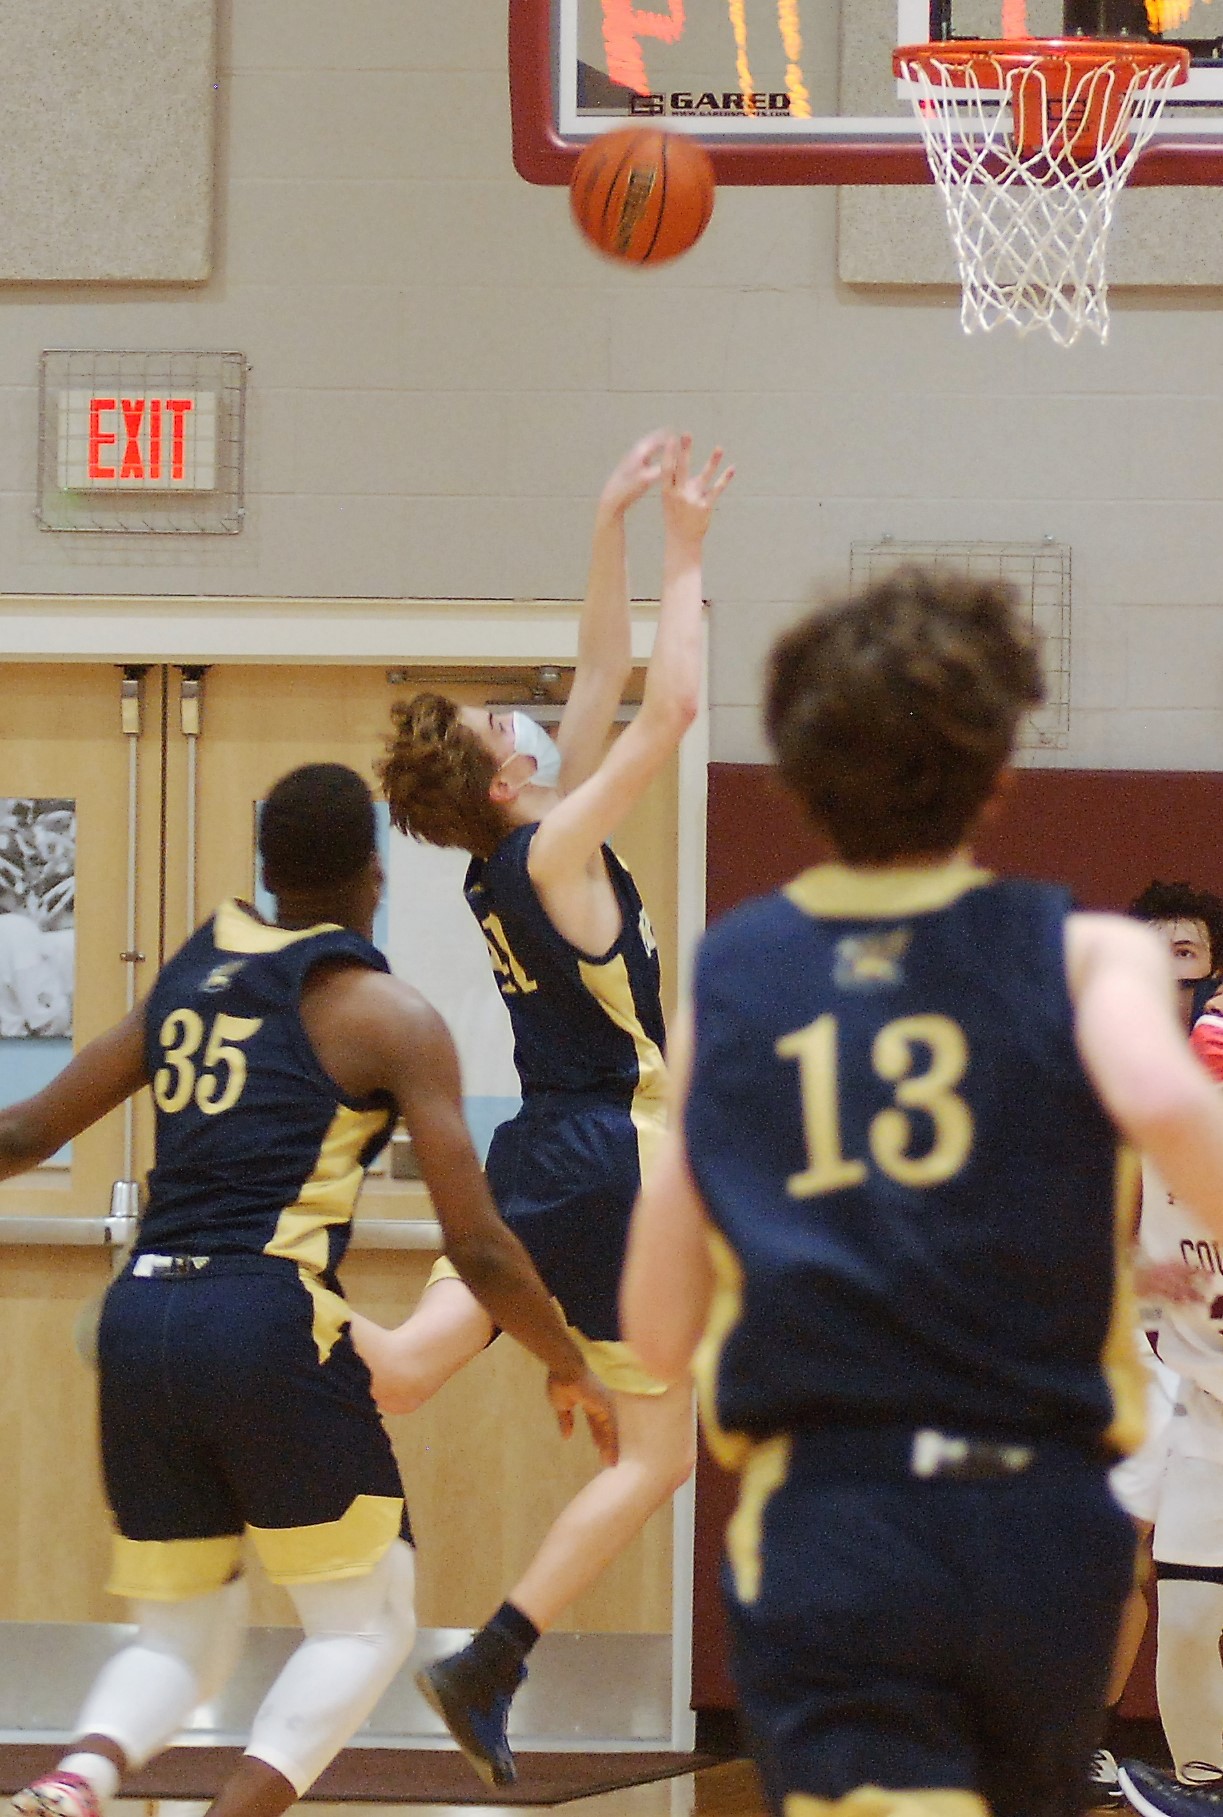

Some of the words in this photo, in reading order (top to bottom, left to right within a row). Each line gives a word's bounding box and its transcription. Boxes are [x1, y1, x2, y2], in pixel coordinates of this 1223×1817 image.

[670, 92, 791, 110] GARED
[88, 398, 194, 480] EXIT
[153, 1007, 265, 1116] 35
[774, 1011, 976, 1200] 13
